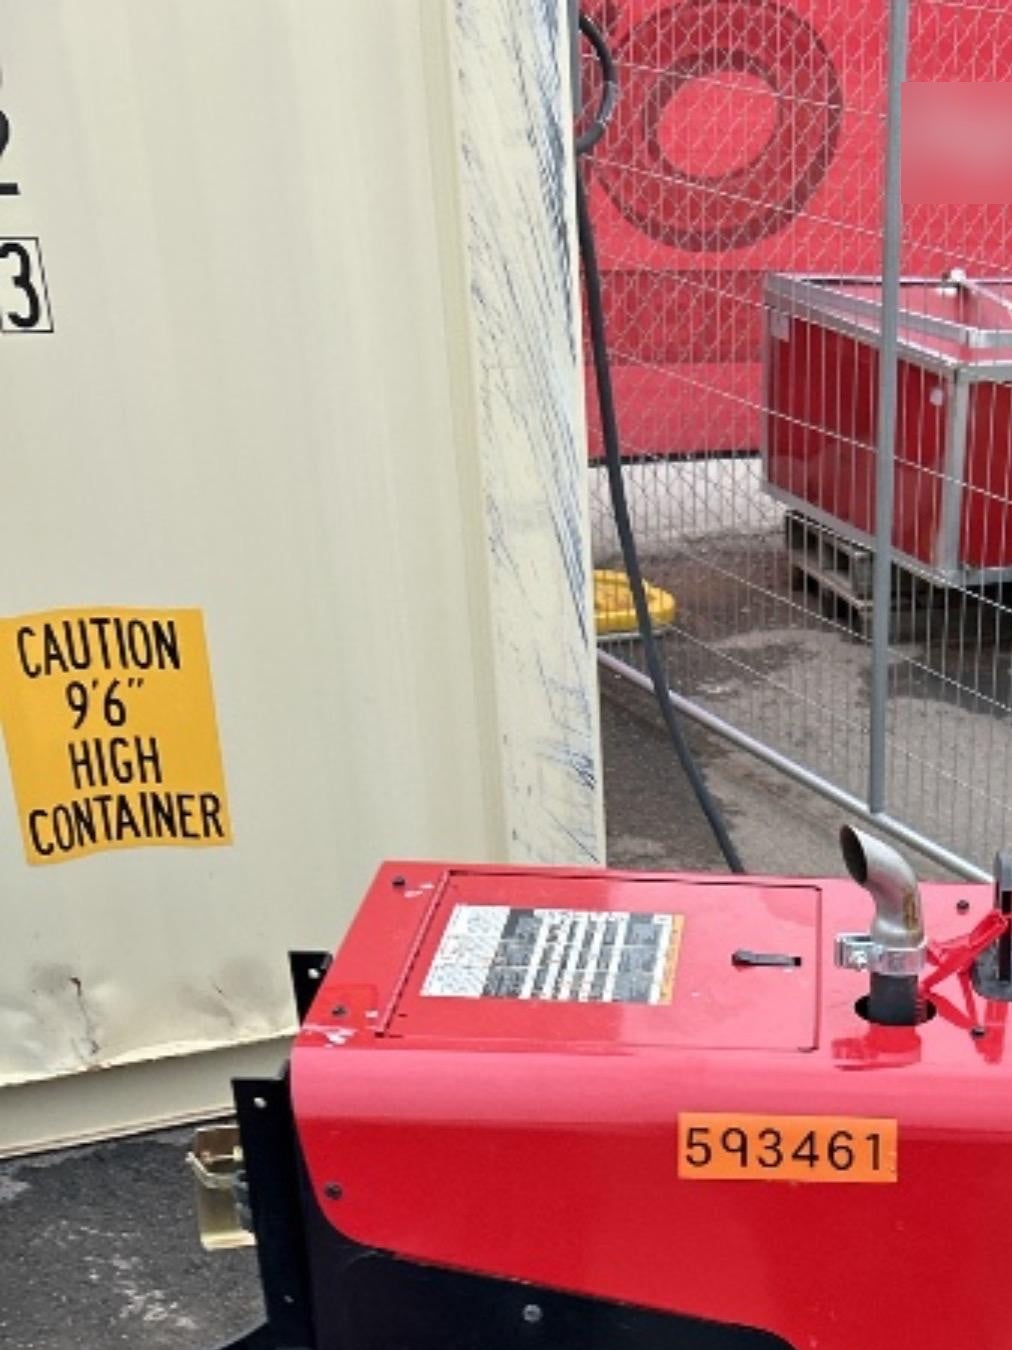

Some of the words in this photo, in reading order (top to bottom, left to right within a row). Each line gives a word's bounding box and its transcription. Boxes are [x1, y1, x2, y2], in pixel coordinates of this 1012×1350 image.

[16, 617, 181, 679] CAUTION
[68, 736, 163, 789] HIGH
[28, 792, 225, 856] CONTAINER
[686, 1127, 881, 1171] 593461
